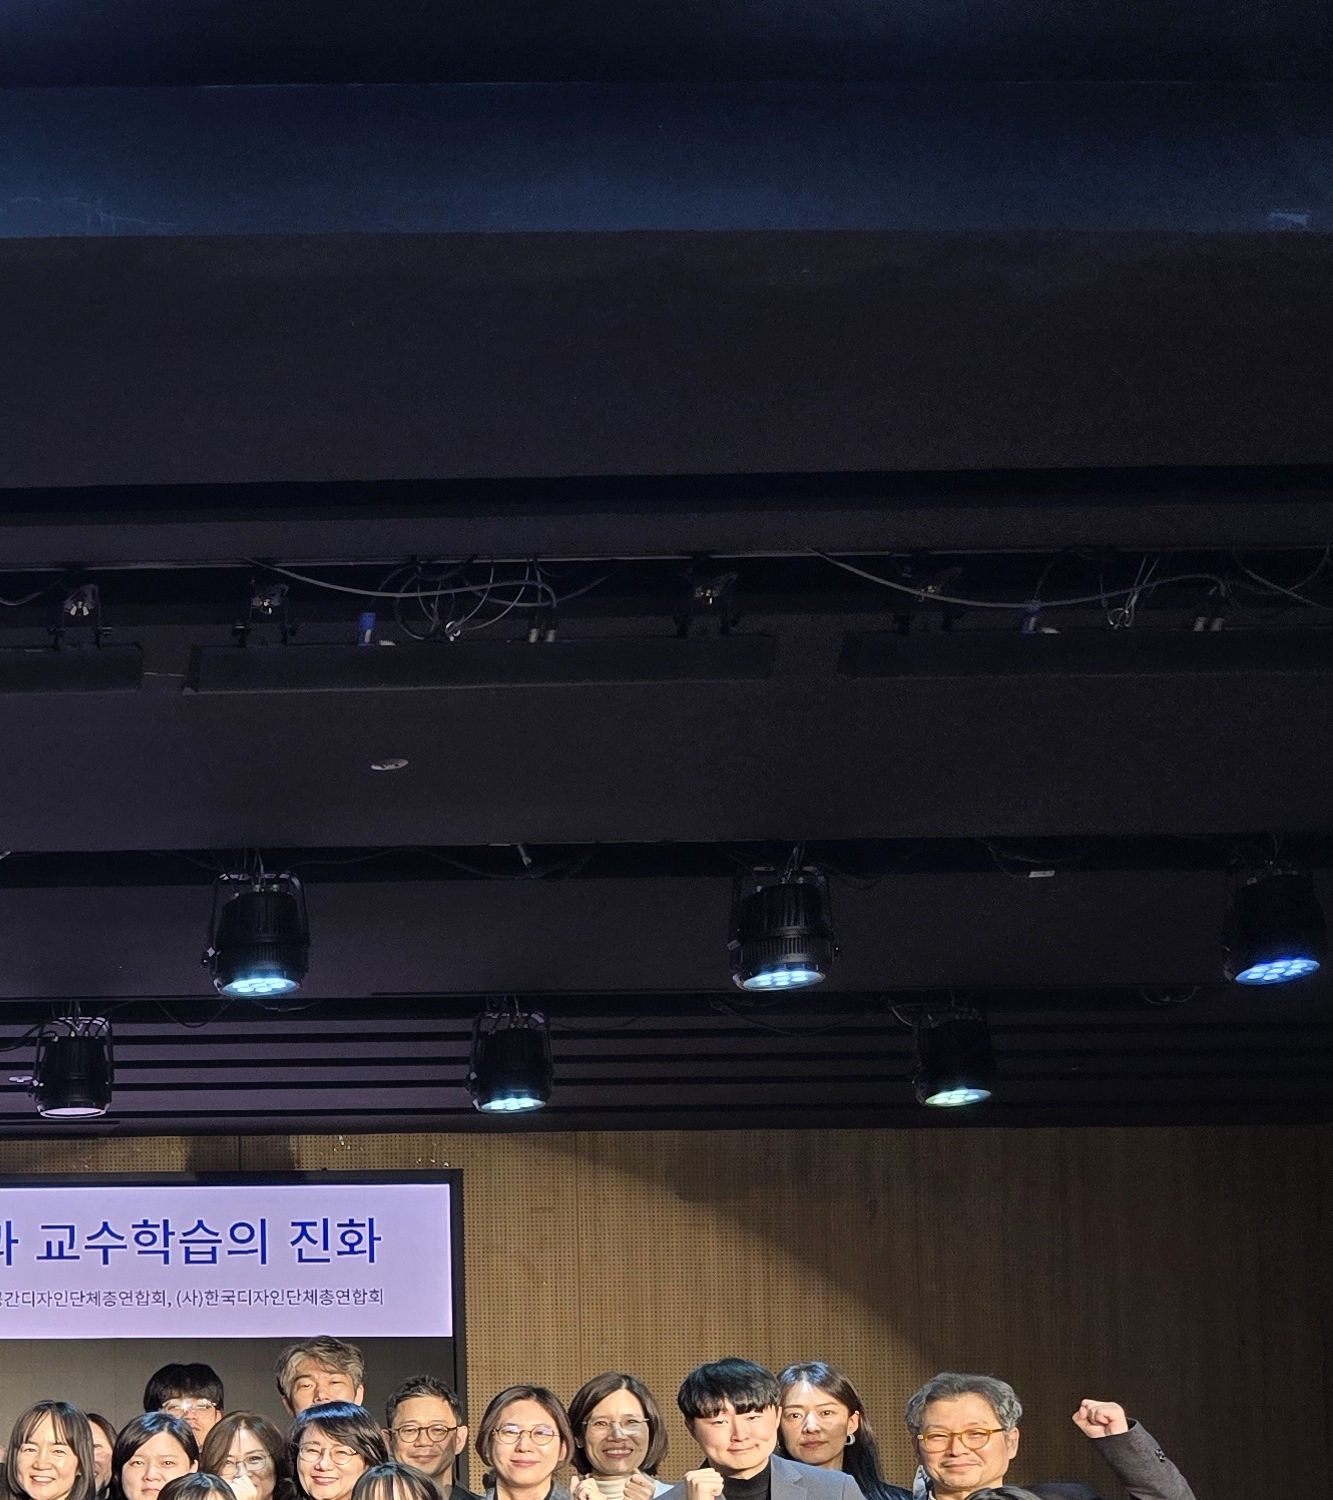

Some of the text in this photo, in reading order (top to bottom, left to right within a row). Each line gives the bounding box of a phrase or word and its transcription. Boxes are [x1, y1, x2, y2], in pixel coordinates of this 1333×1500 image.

[35, 1217, 268, 1266] 교수학습의
[289, 1217, 382, 1264] 진화
[176, 1287, 384, 1309] (사)한국디자인단체총연합회
